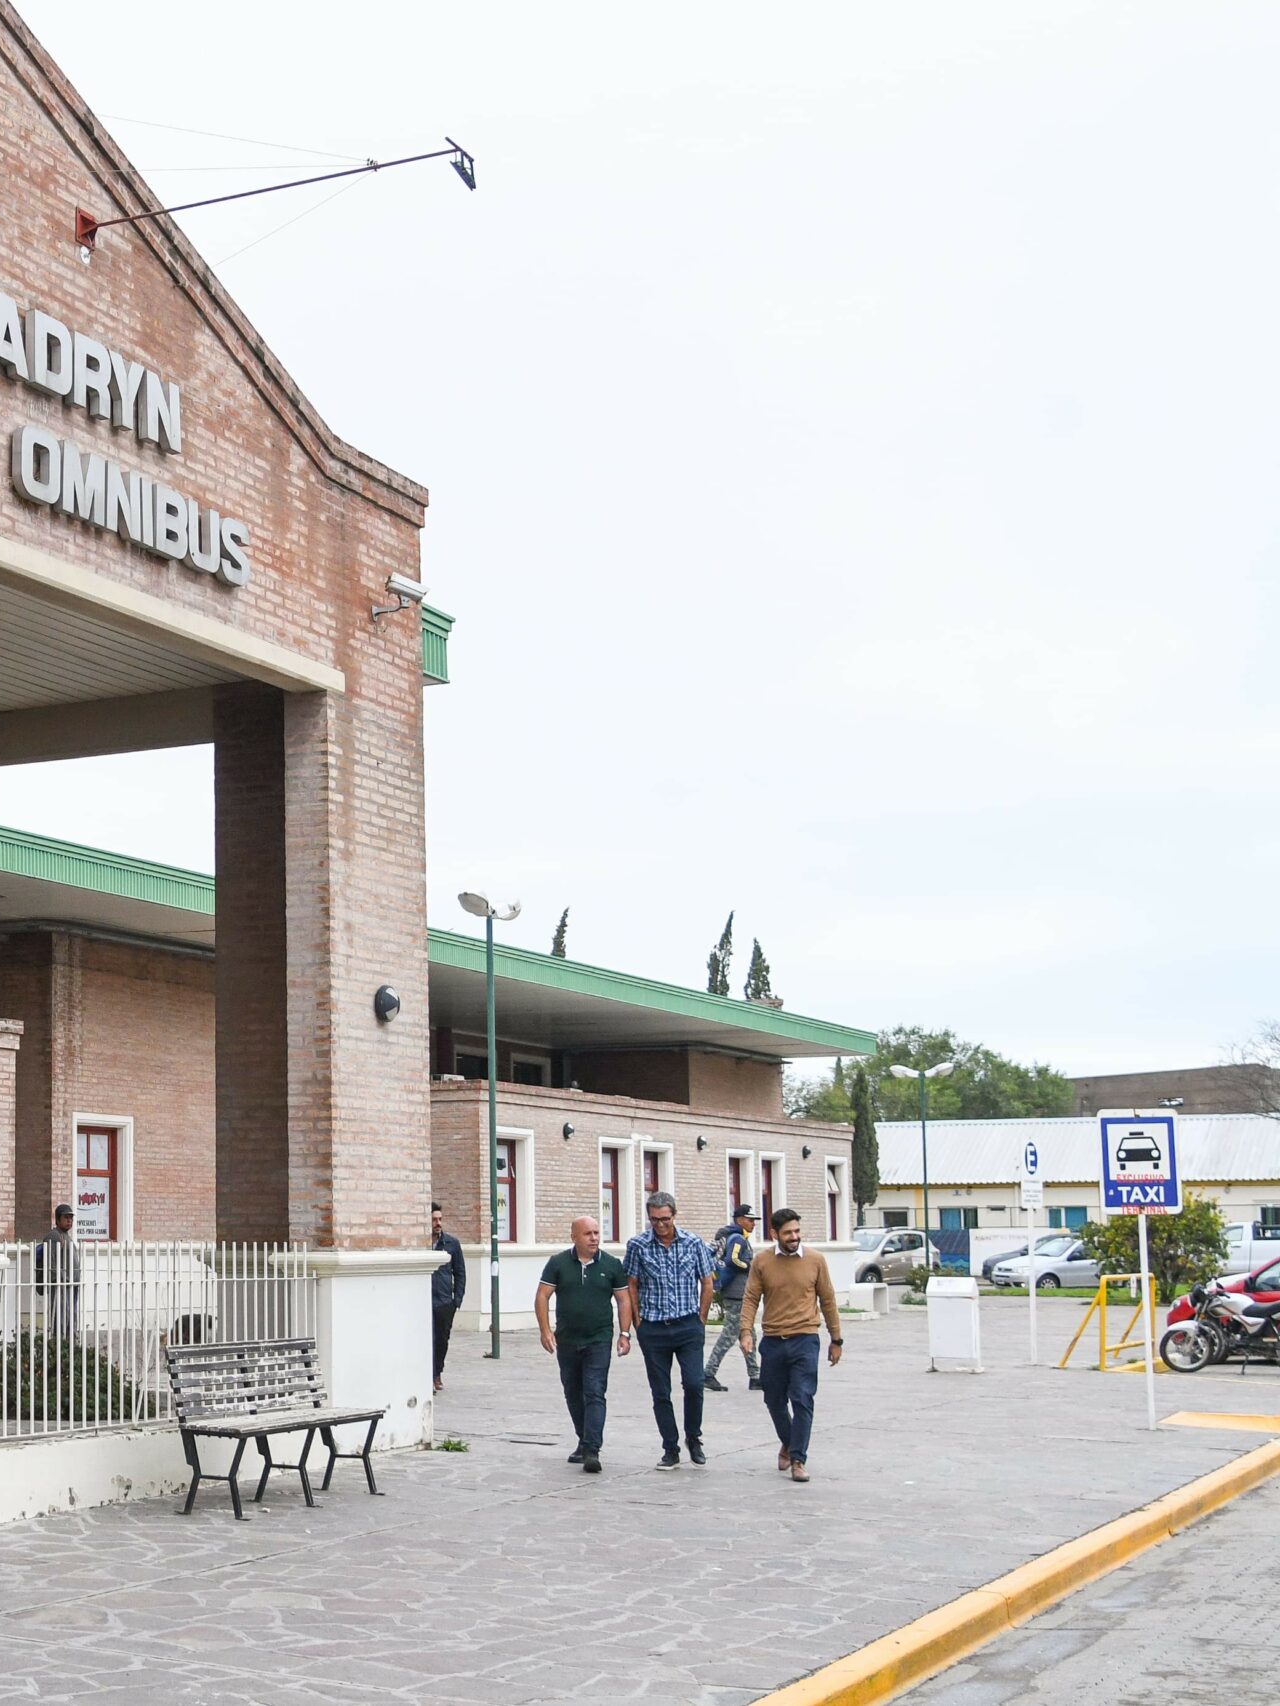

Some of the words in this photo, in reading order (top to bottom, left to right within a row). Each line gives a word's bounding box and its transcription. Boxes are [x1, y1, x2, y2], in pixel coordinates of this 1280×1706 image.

[12, 425, 250, 587] OMNIBUS
[1026, 1145, 1036, 1172] E
[1116, 1173, 1165, 1184] EXCLUSIVO
[1117, 1185, 1165, 1203] TAXI
